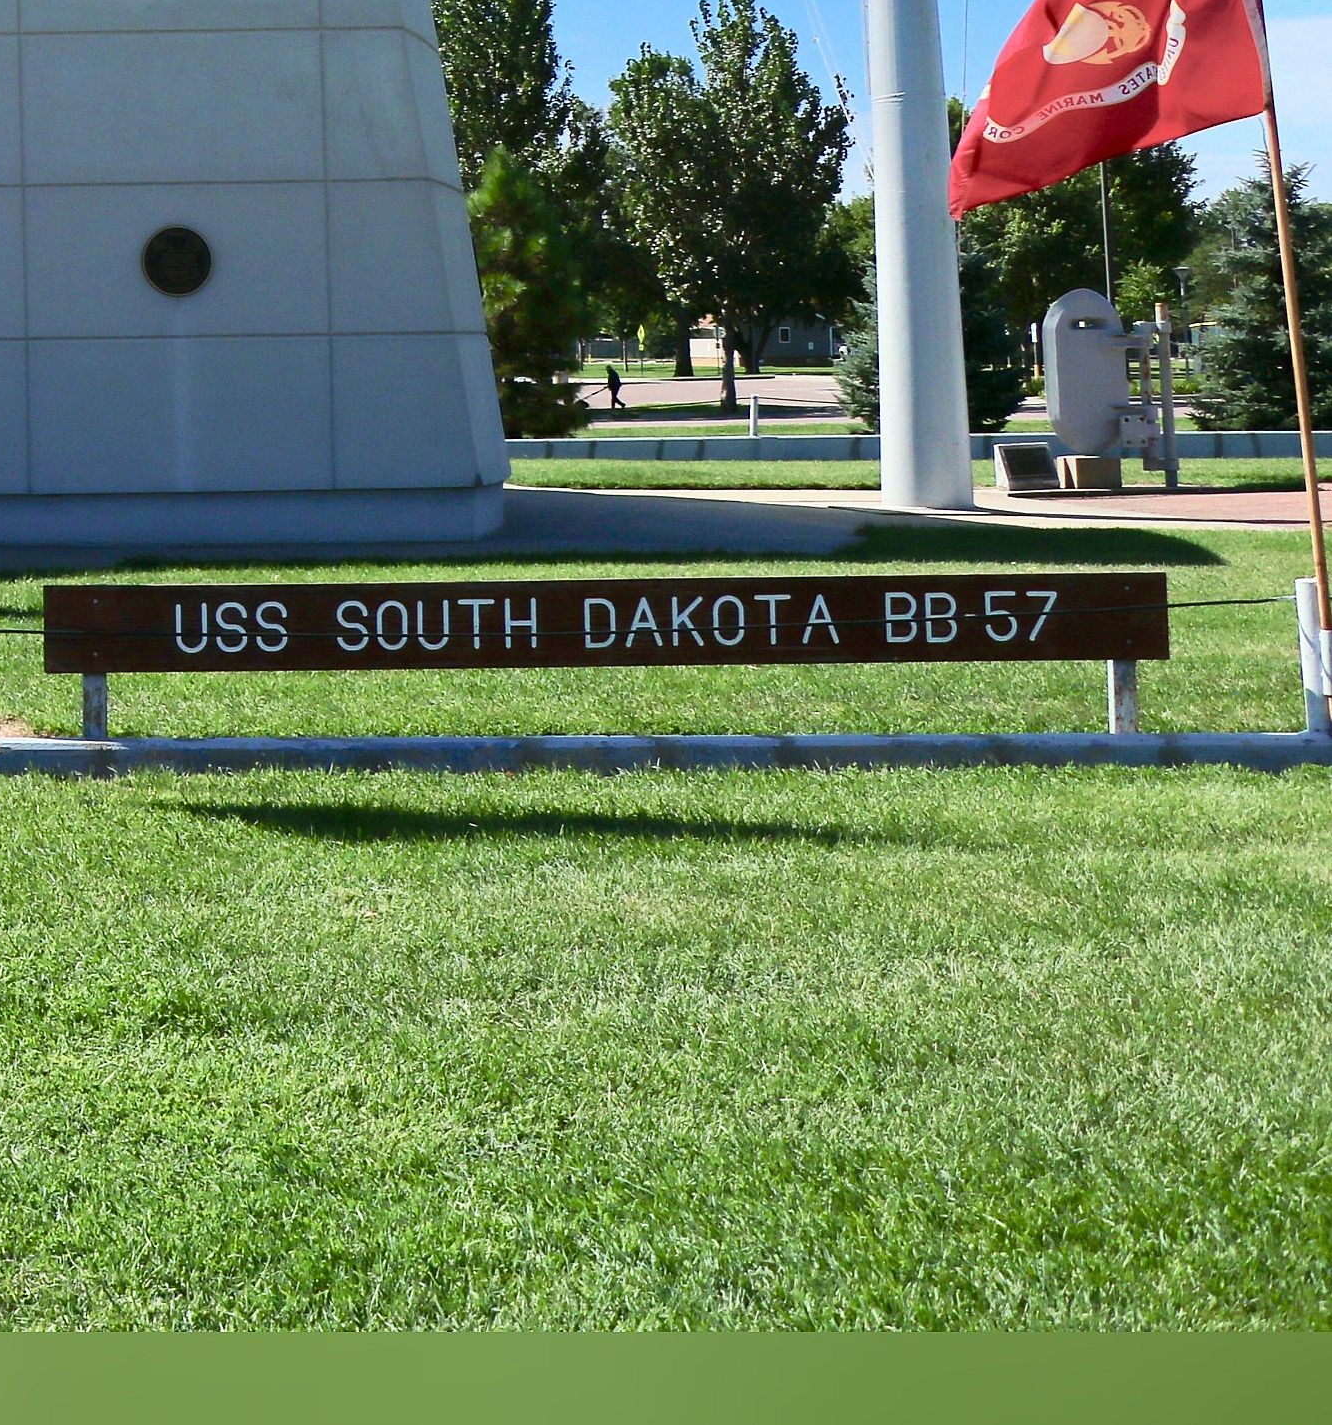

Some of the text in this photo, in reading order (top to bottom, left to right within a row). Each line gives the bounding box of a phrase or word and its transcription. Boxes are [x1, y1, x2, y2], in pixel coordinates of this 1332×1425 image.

[175, 590, 1059, 654] USS SOUTH DAKOTA BB-57
